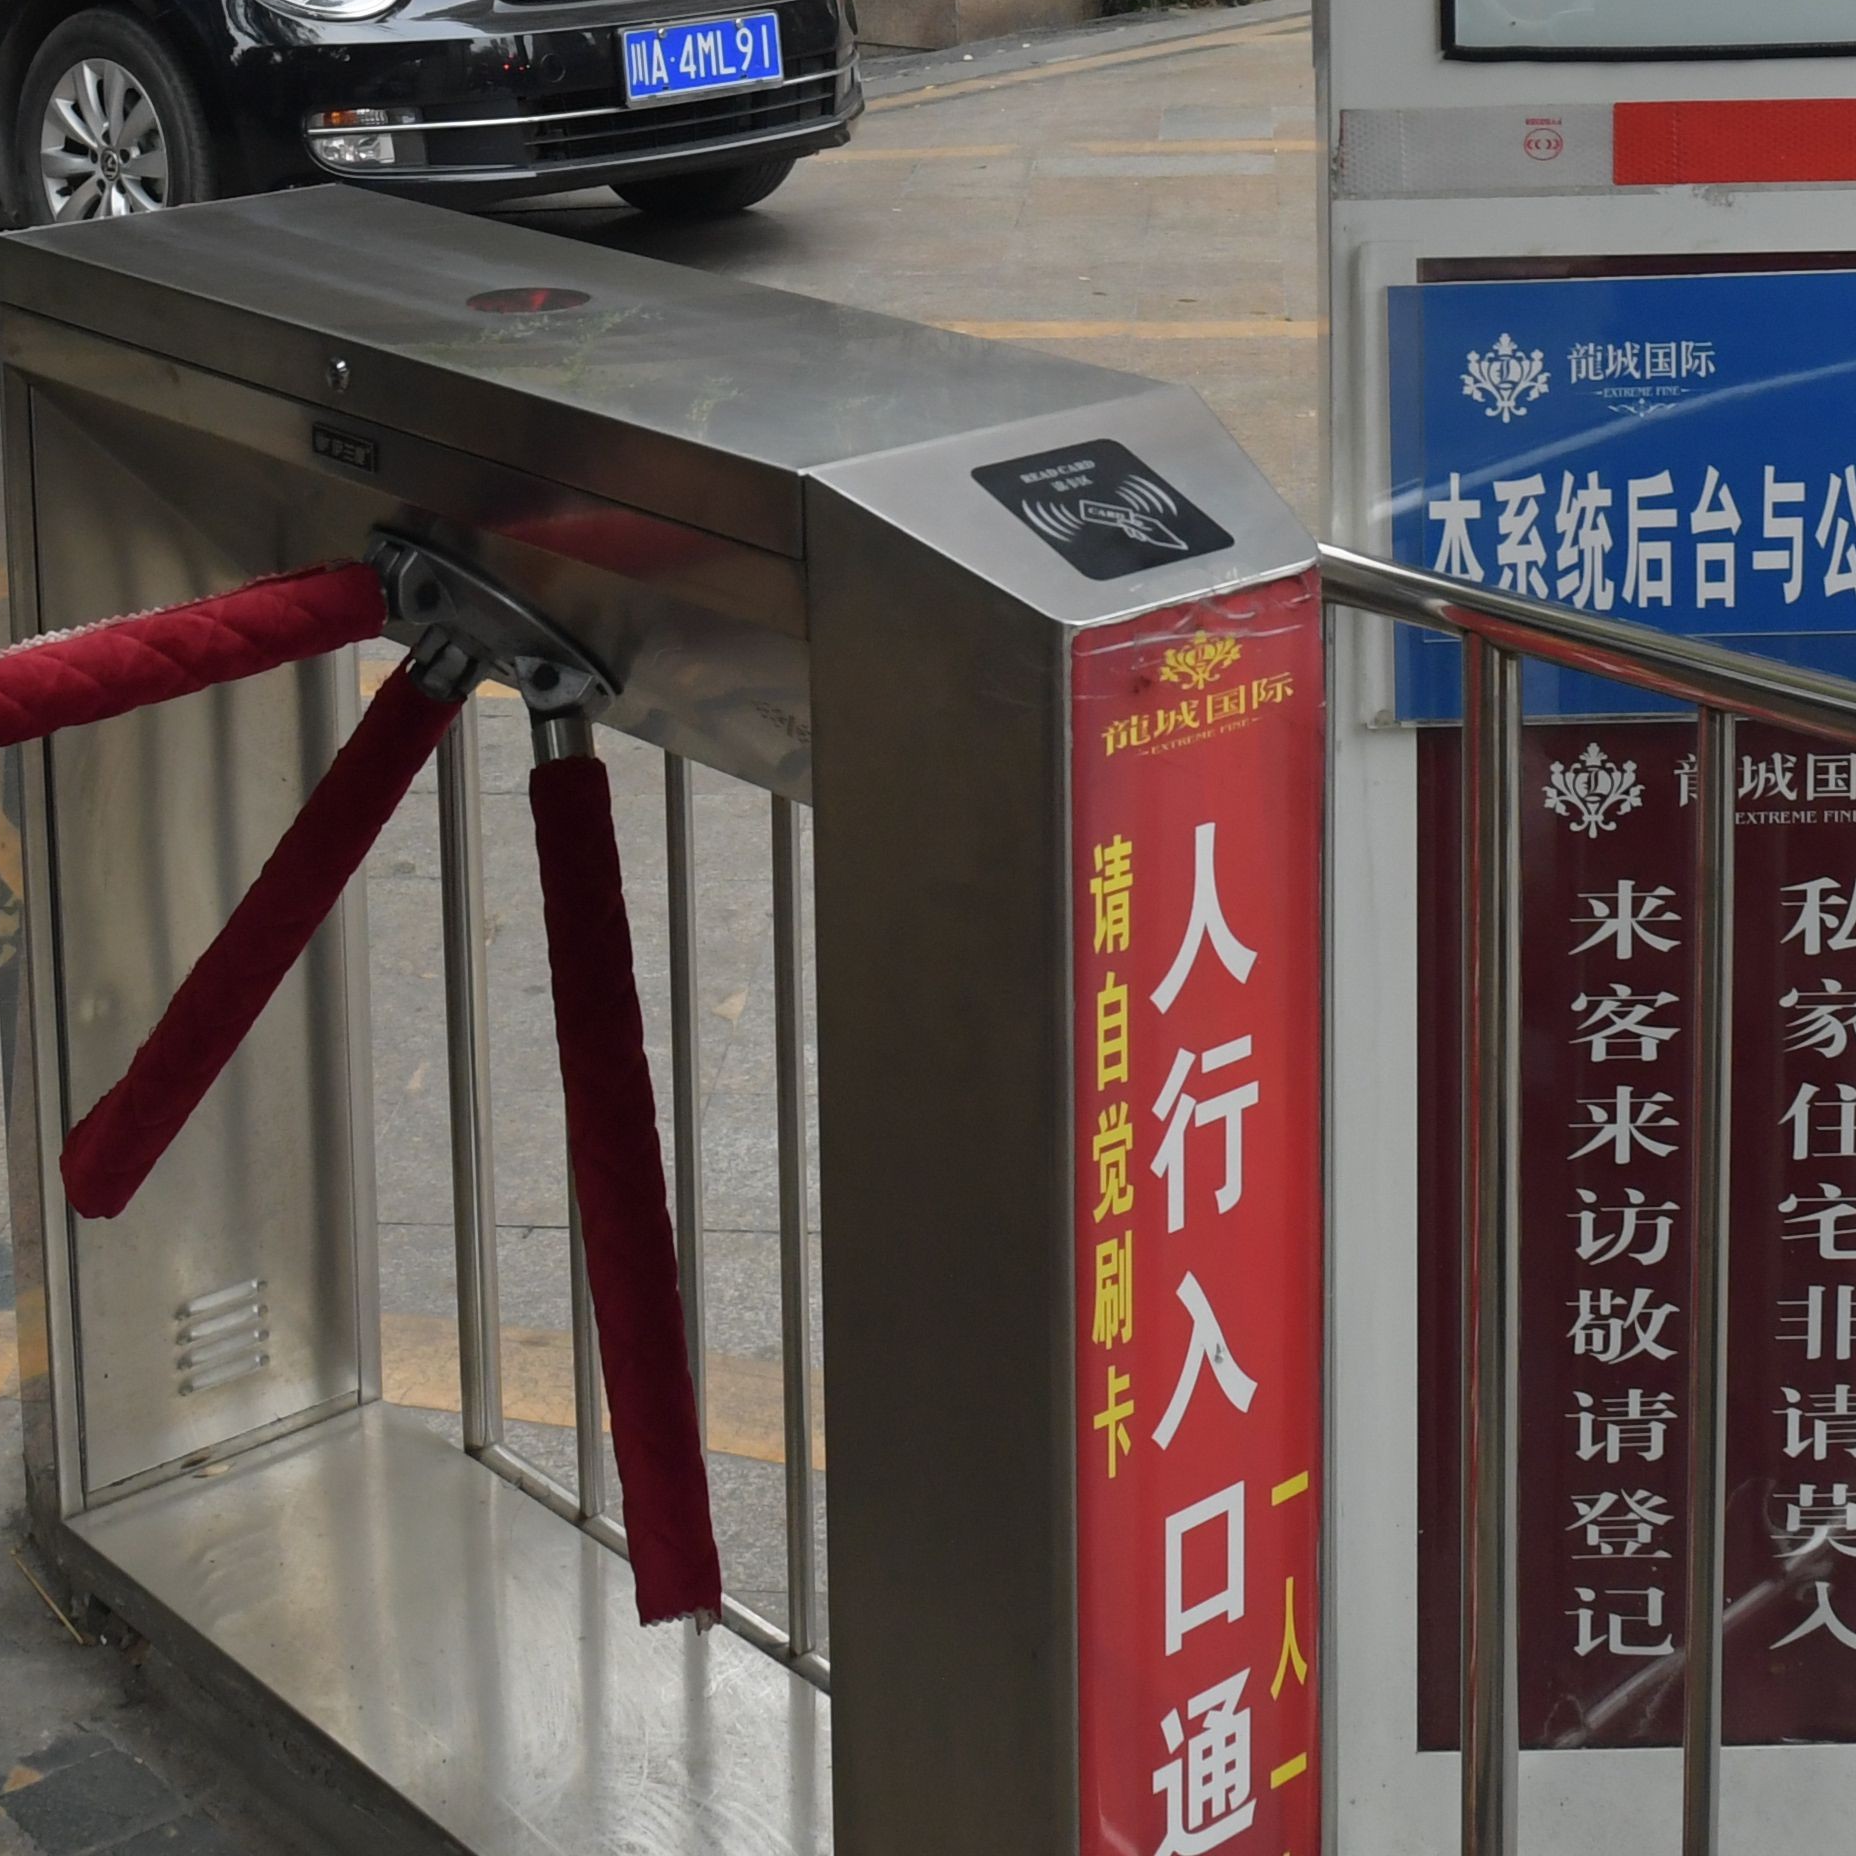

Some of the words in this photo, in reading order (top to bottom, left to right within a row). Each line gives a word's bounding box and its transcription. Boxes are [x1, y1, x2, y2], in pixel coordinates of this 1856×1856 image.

[1567, 341, 1716, 384] 龍城国际
[1102, 672, 1294, 756] 龍城国际
[1735, 810, 1817, 825] EXTREME
[1090, 834, 1134, 1478] 请自觉刷卡
[1563, 880, 1682, 1658] 来客来访敬请登记
[1149, 821, 1259, 1856] 人行入口通
